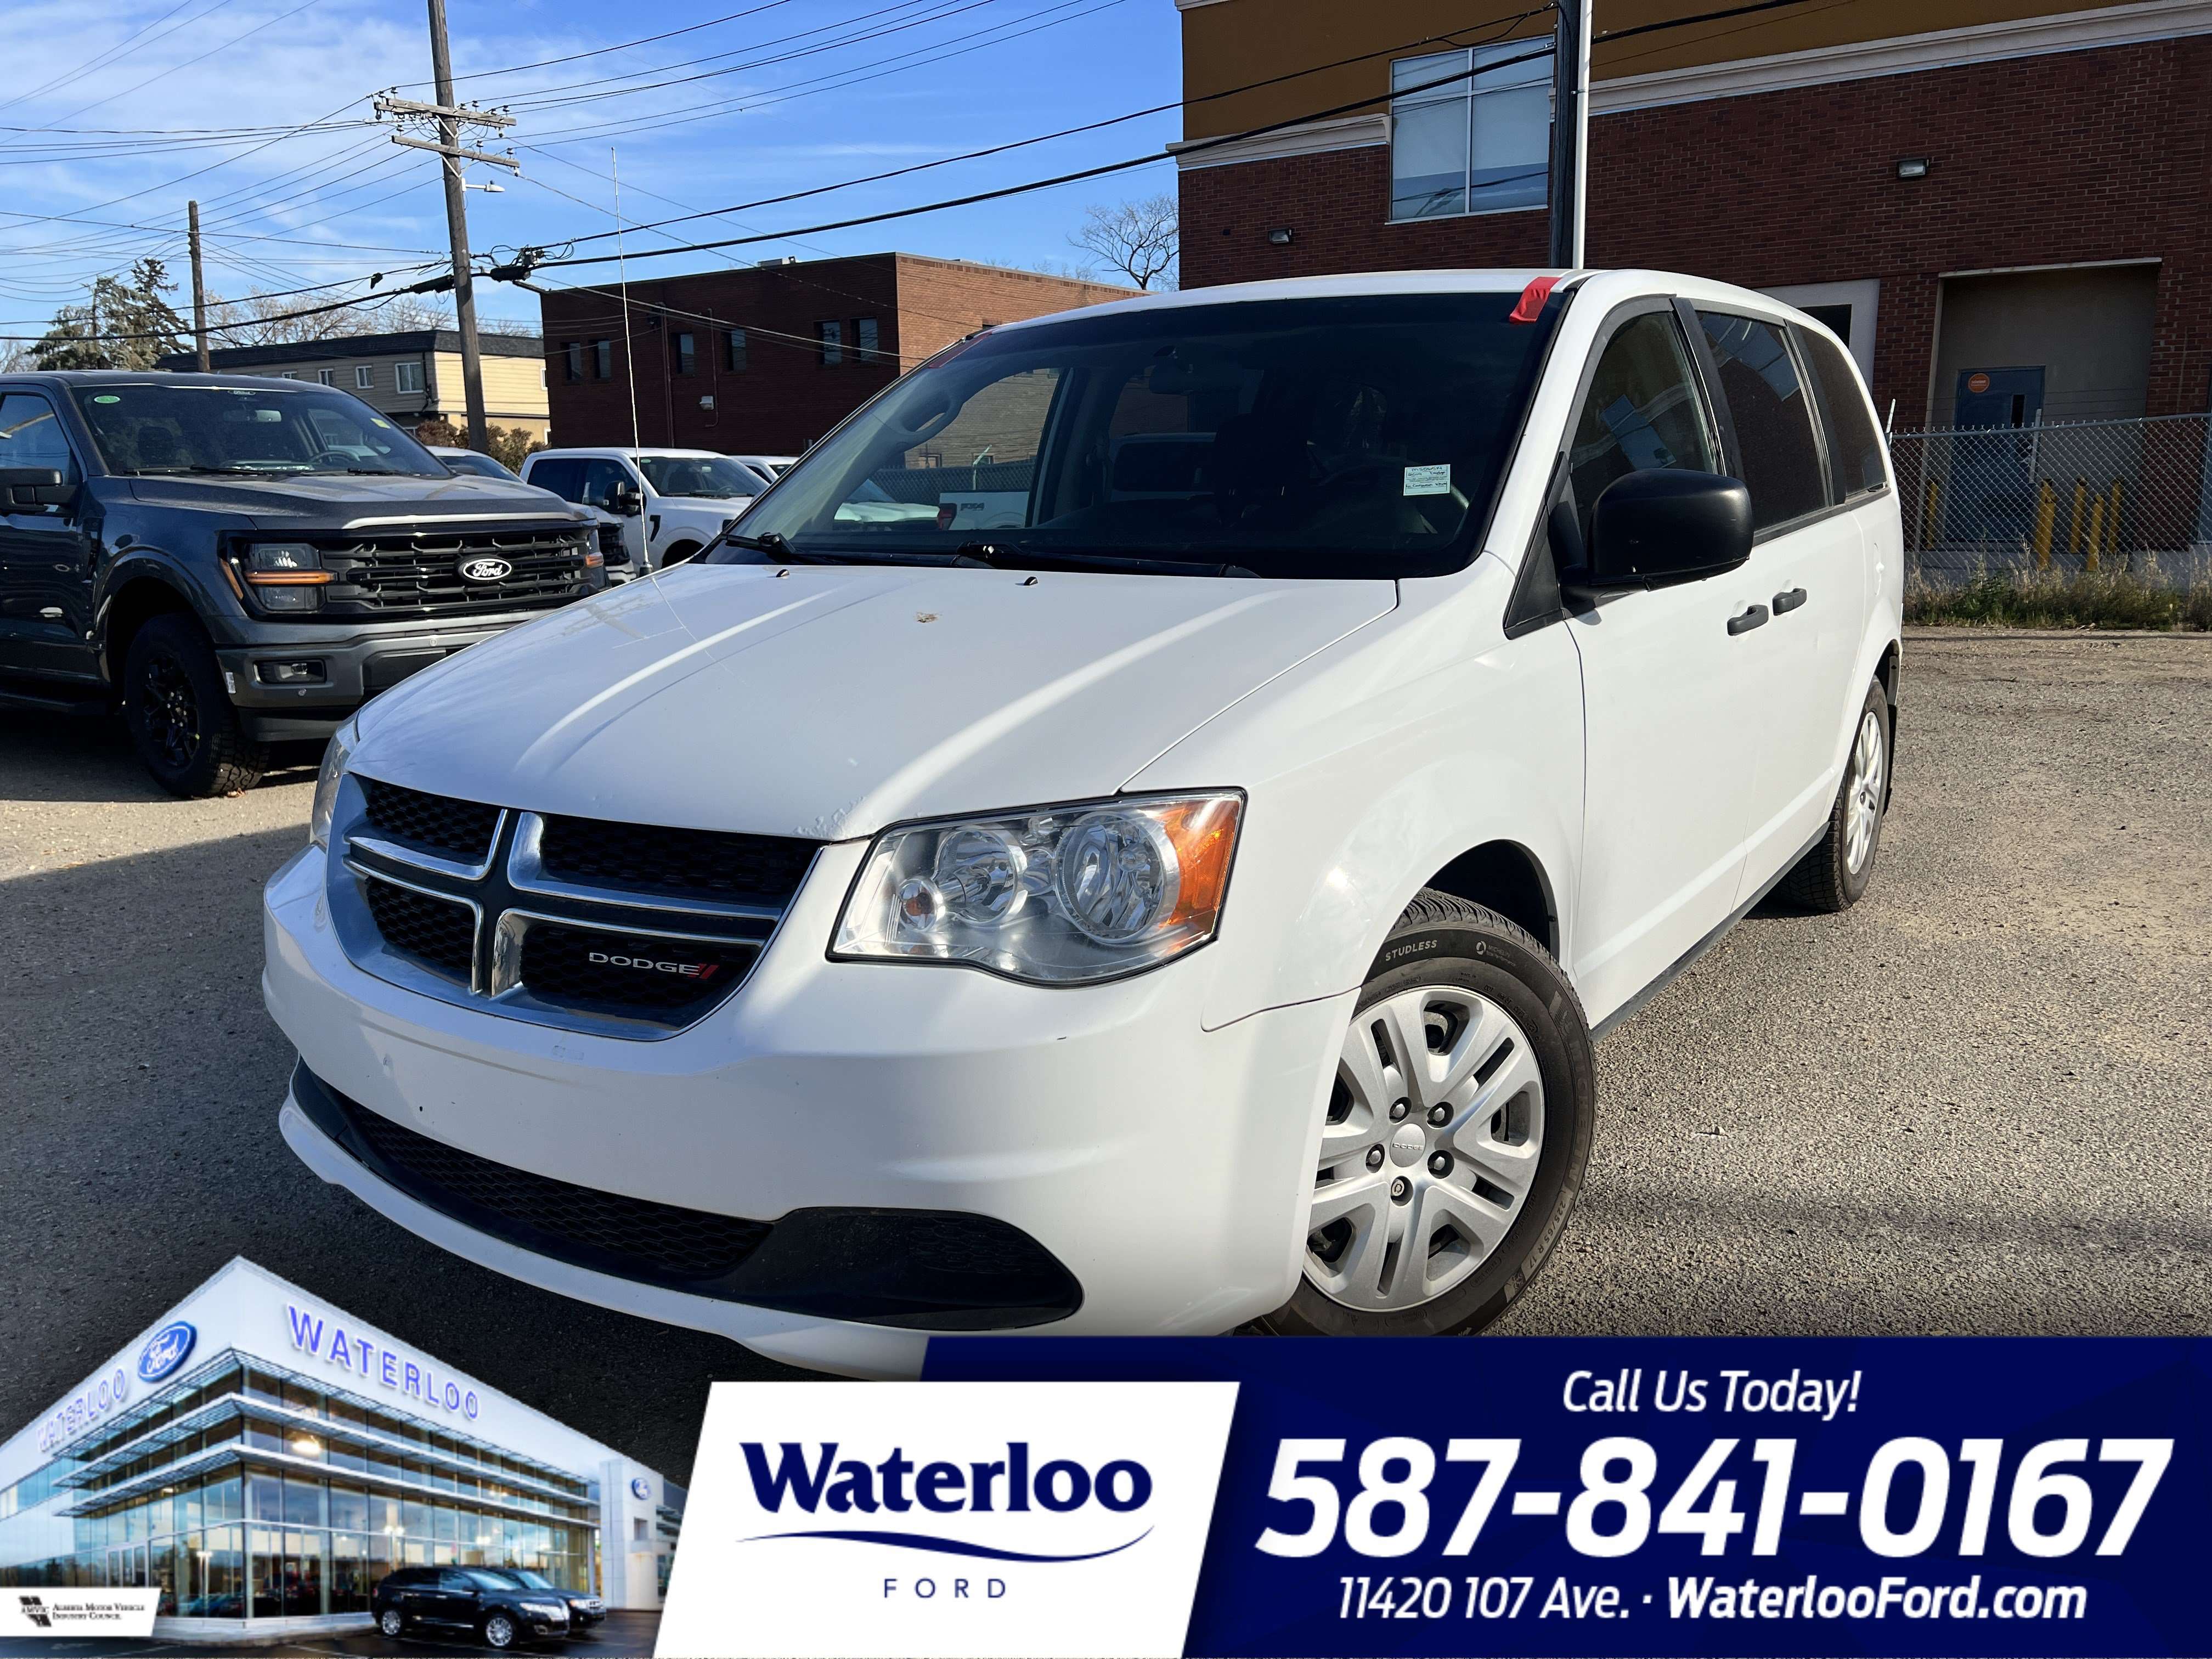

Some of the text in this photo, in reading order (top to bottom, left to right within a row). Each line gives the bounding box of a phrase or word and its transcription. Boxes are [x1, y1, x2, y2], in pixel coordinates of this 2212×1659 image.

[472, 562, 503, 577] Ford
[1385, 939, 1437, 962] STUDLESS
[589, 952, 701, 975] DODGE
[1392, 1142, 1424, 1150] DODGE
[1528, 1200, 1566, 1269] 225/65 R 17
